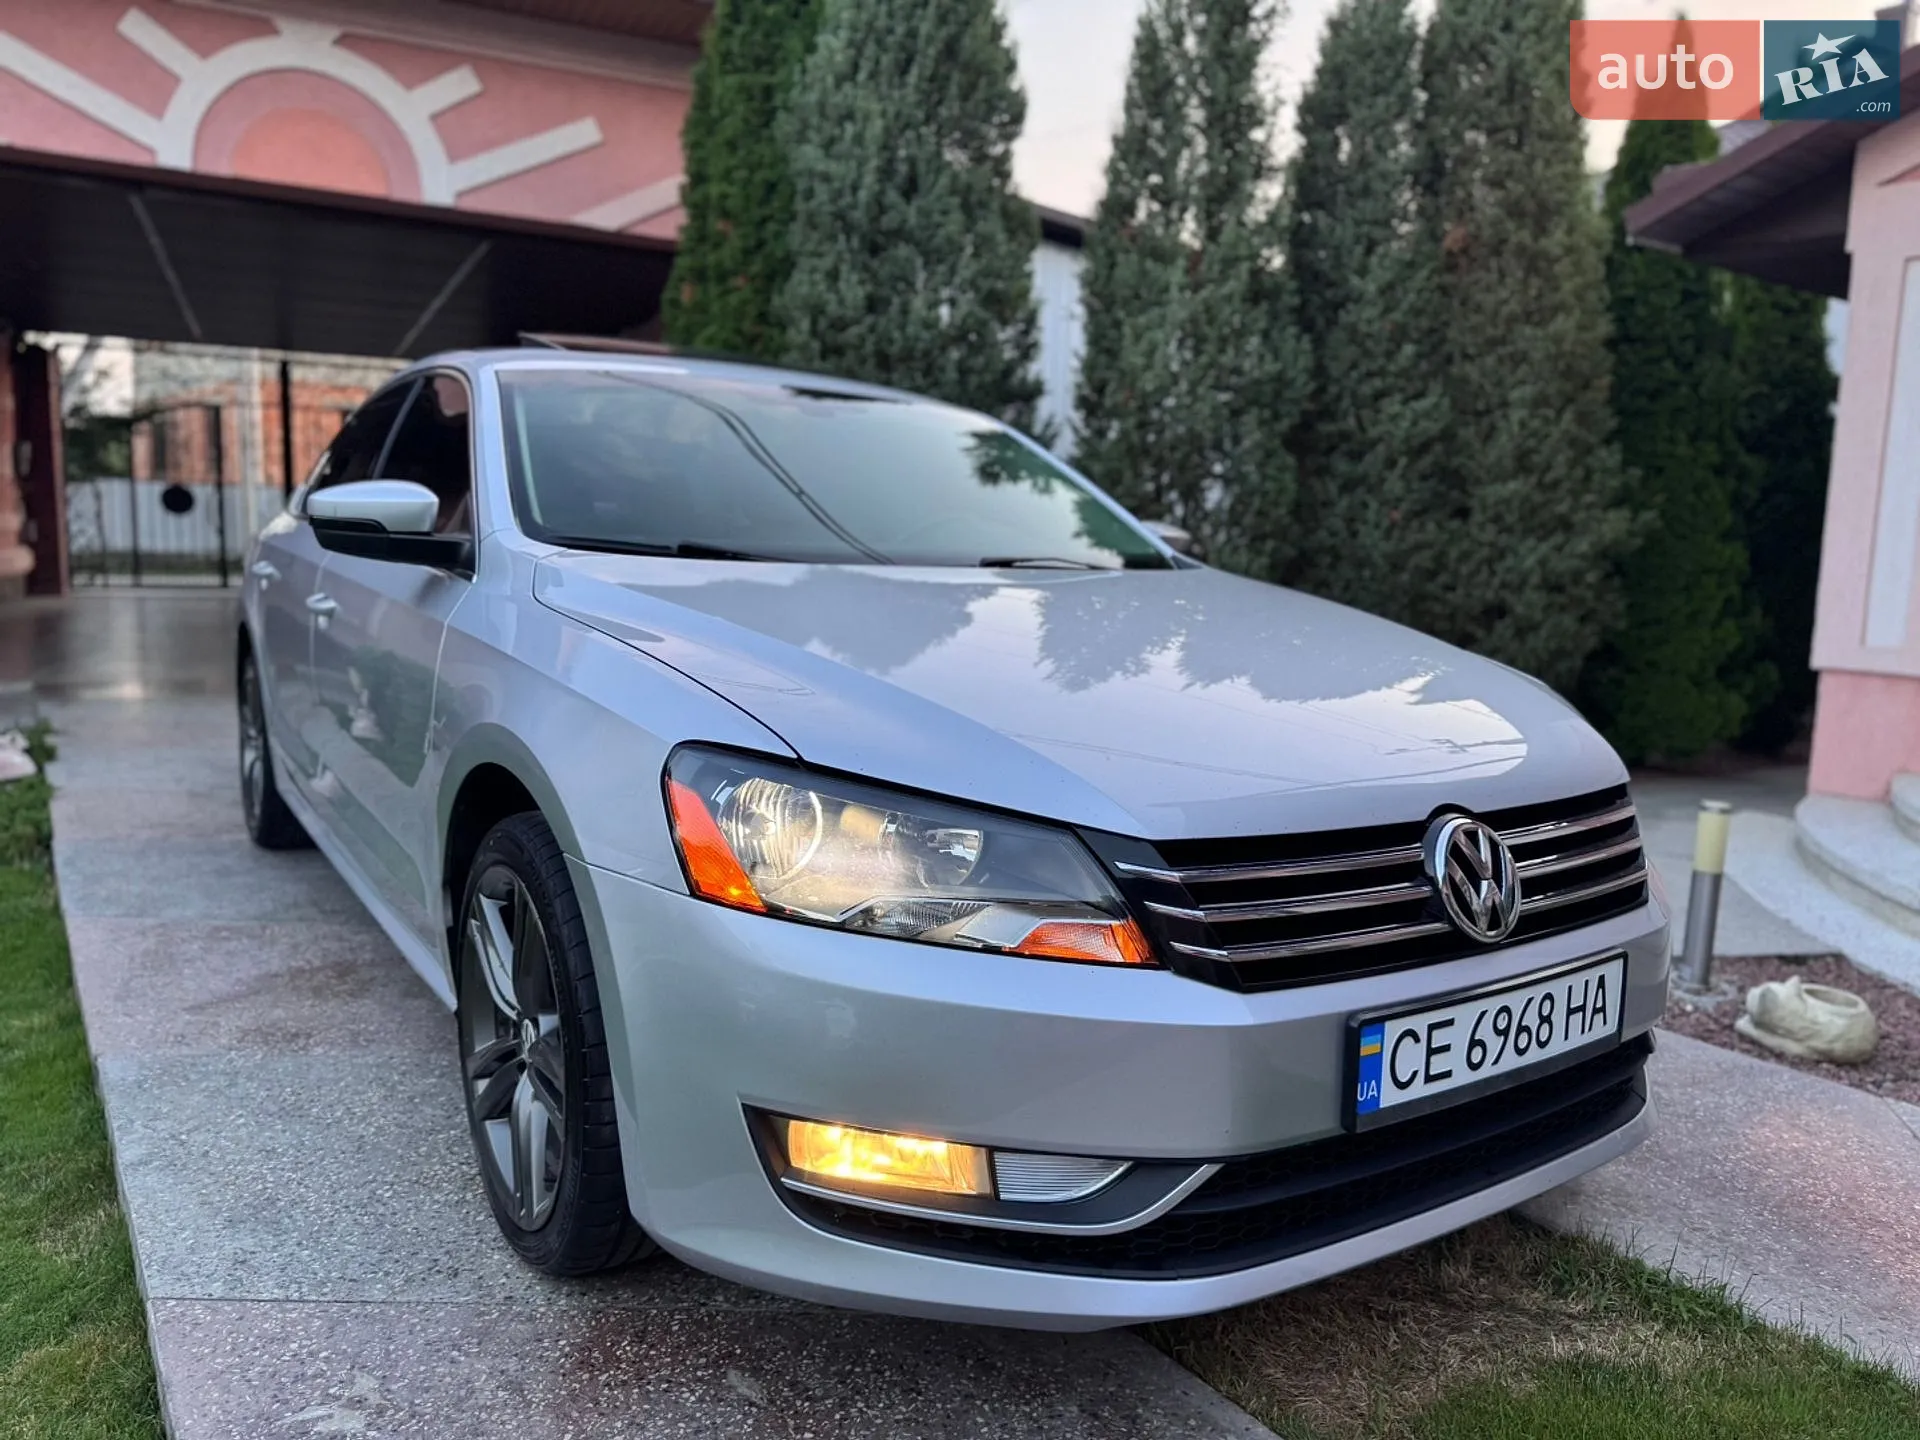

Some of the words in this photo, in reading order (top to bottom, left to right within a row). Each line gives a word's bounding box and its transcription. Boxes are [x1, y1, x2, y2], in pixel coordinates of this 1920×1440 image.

[1389, 1017, 1455, 1090] CE
[1466, 991, 1554, 1072] 6968
[1564, 973, 1608, 1041] HA
[1357, 1079, 1378, 1101] UA
